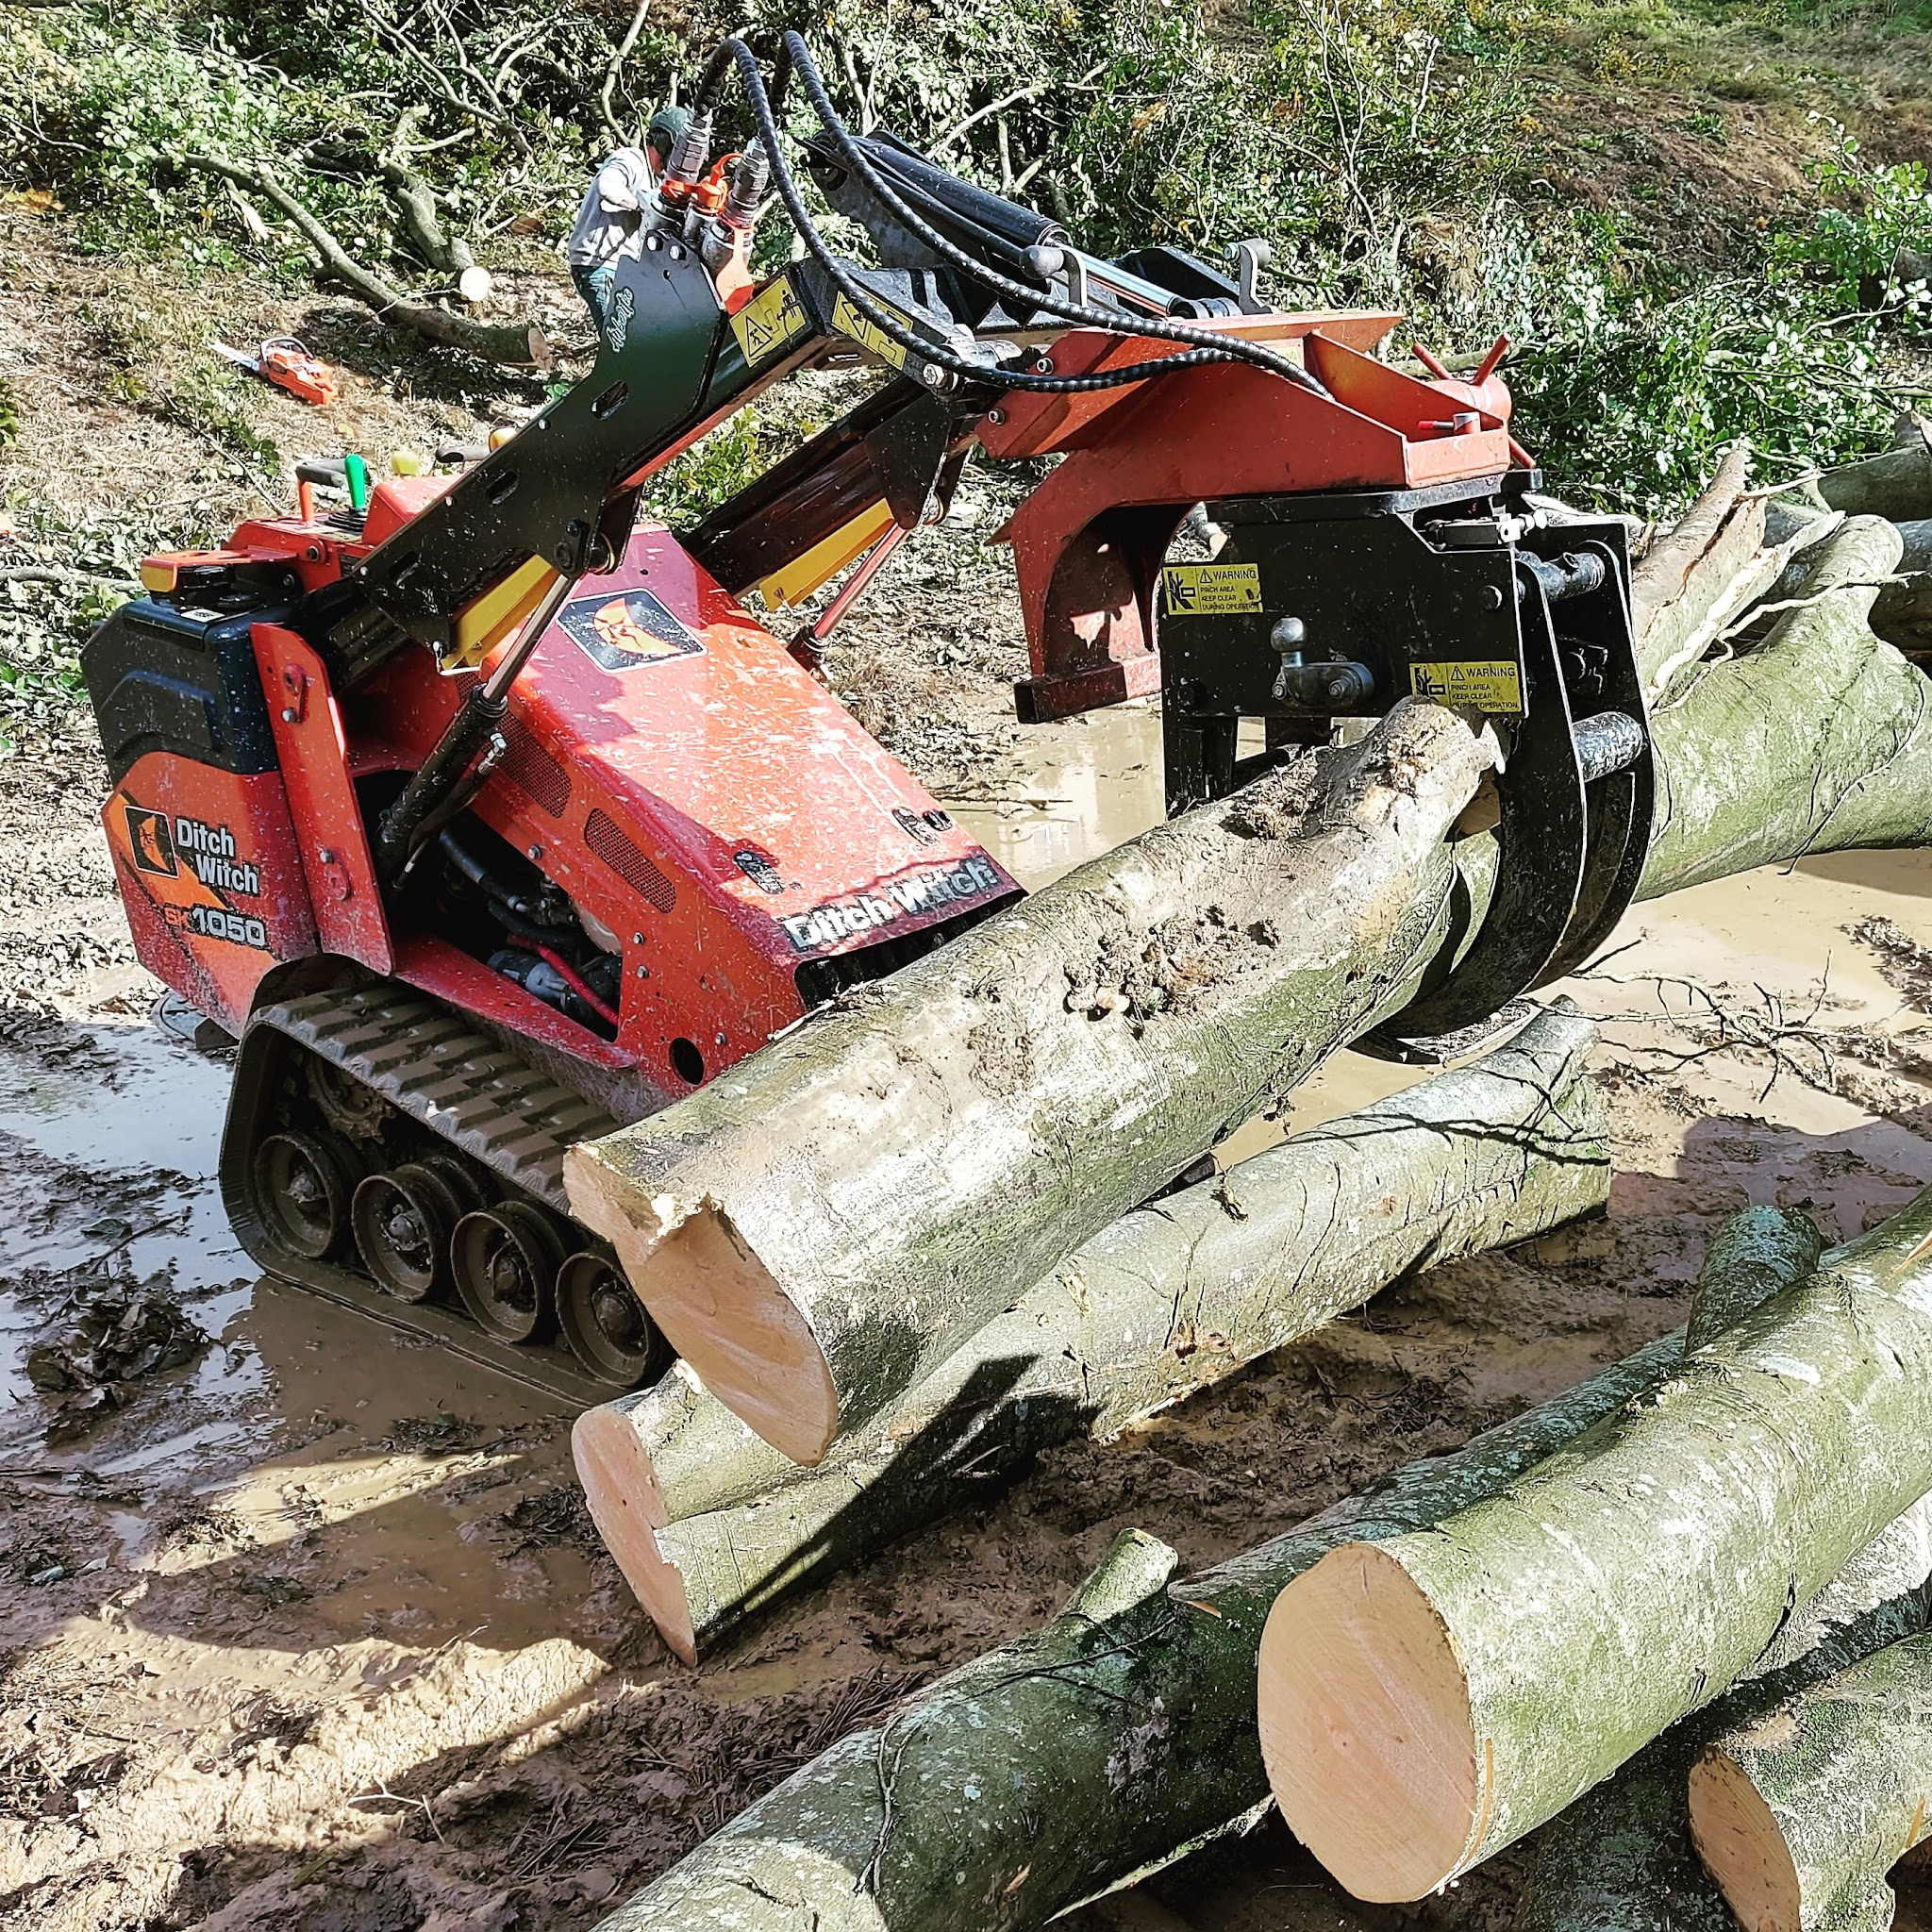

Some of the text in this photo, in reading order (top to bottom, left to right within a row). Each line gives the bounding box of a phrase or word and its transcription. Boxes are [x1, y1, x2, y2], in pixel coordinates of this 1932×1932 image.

[1212, 569, 1257, 580] WARNING
[1466, 667, 1515, 678] WARNING
[176, 818, 235, 857] Ditch
[196, 854, 258, 894] Witch
[782, 857, 998, 946] Ditch Witch
